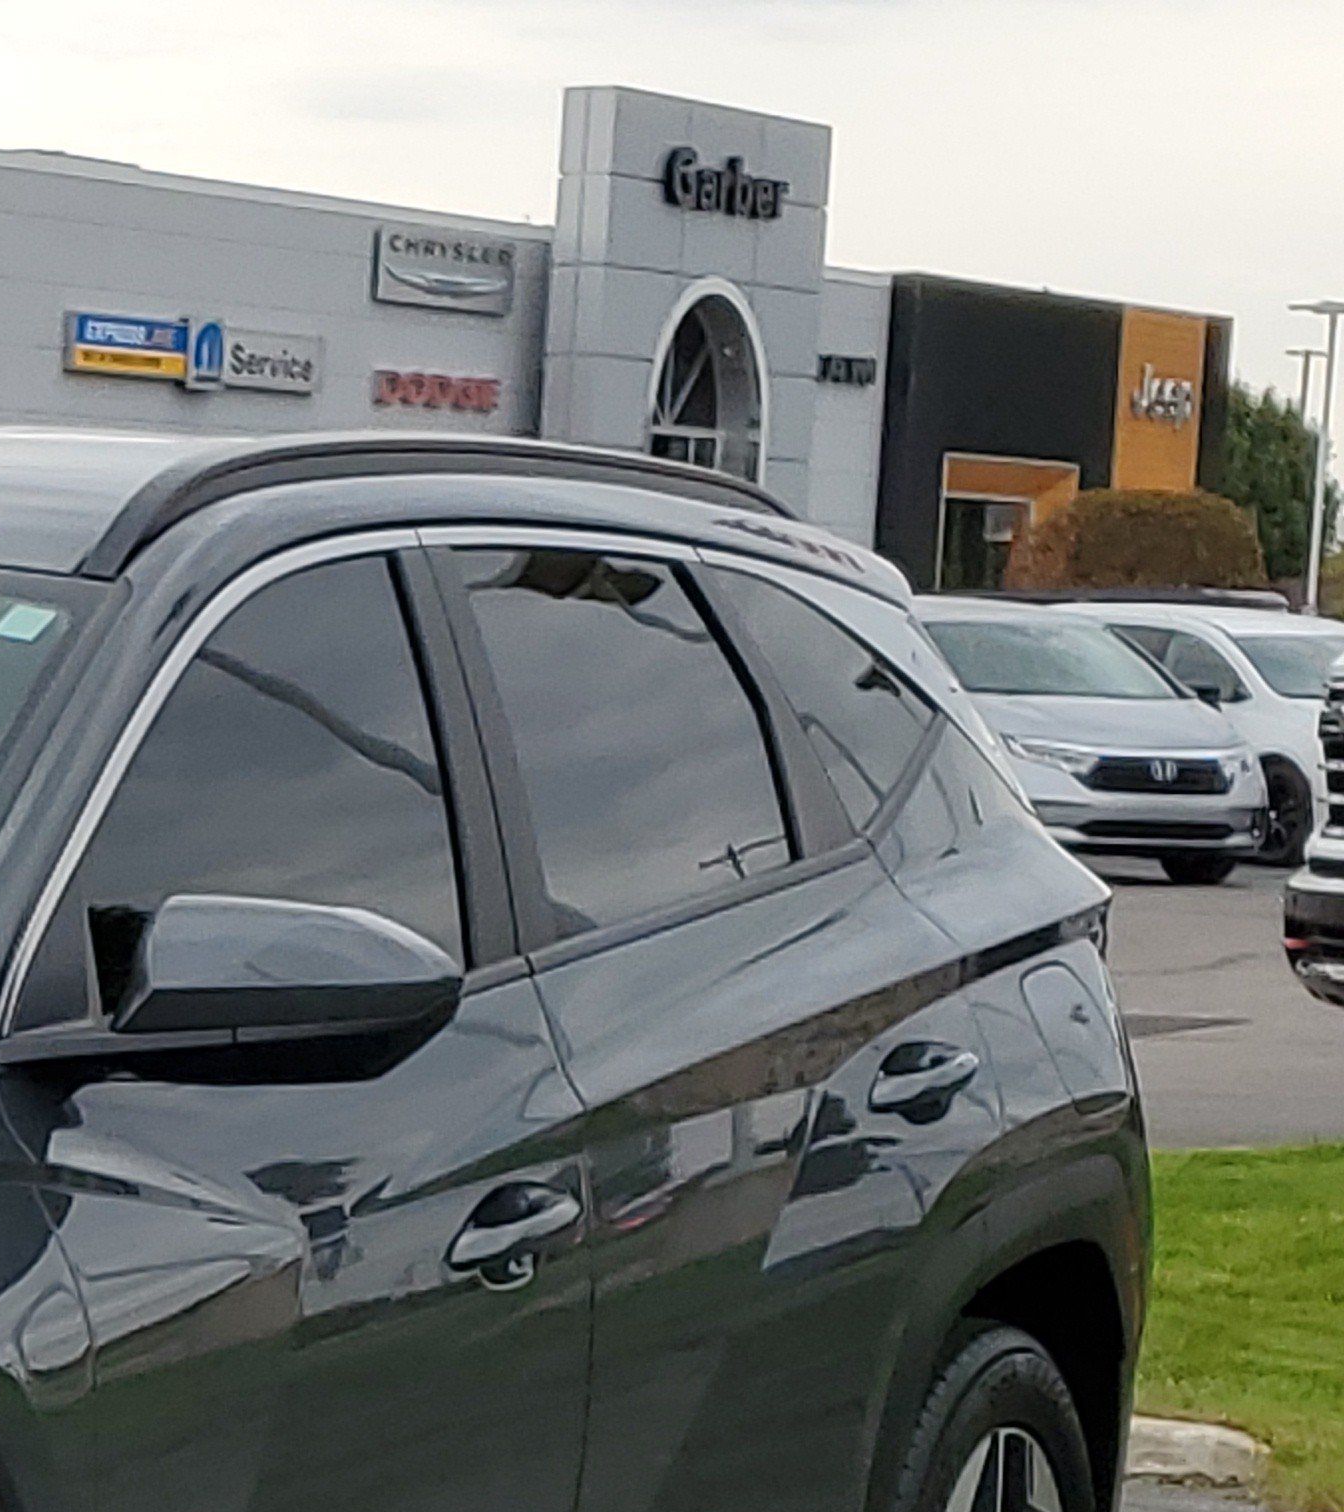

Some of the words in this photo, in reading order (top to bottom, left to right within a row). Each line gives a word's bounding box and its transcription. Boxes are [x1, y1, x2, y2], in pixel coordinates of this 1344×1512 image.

[663, 147, 790, 219] Garber
[388, 233, 513, 267] CHRYSLER
[229, 343, 313, 383] Service
[373, 369, 502, 414] DODGE
[1130, 361, 1193, 430] Jeep
